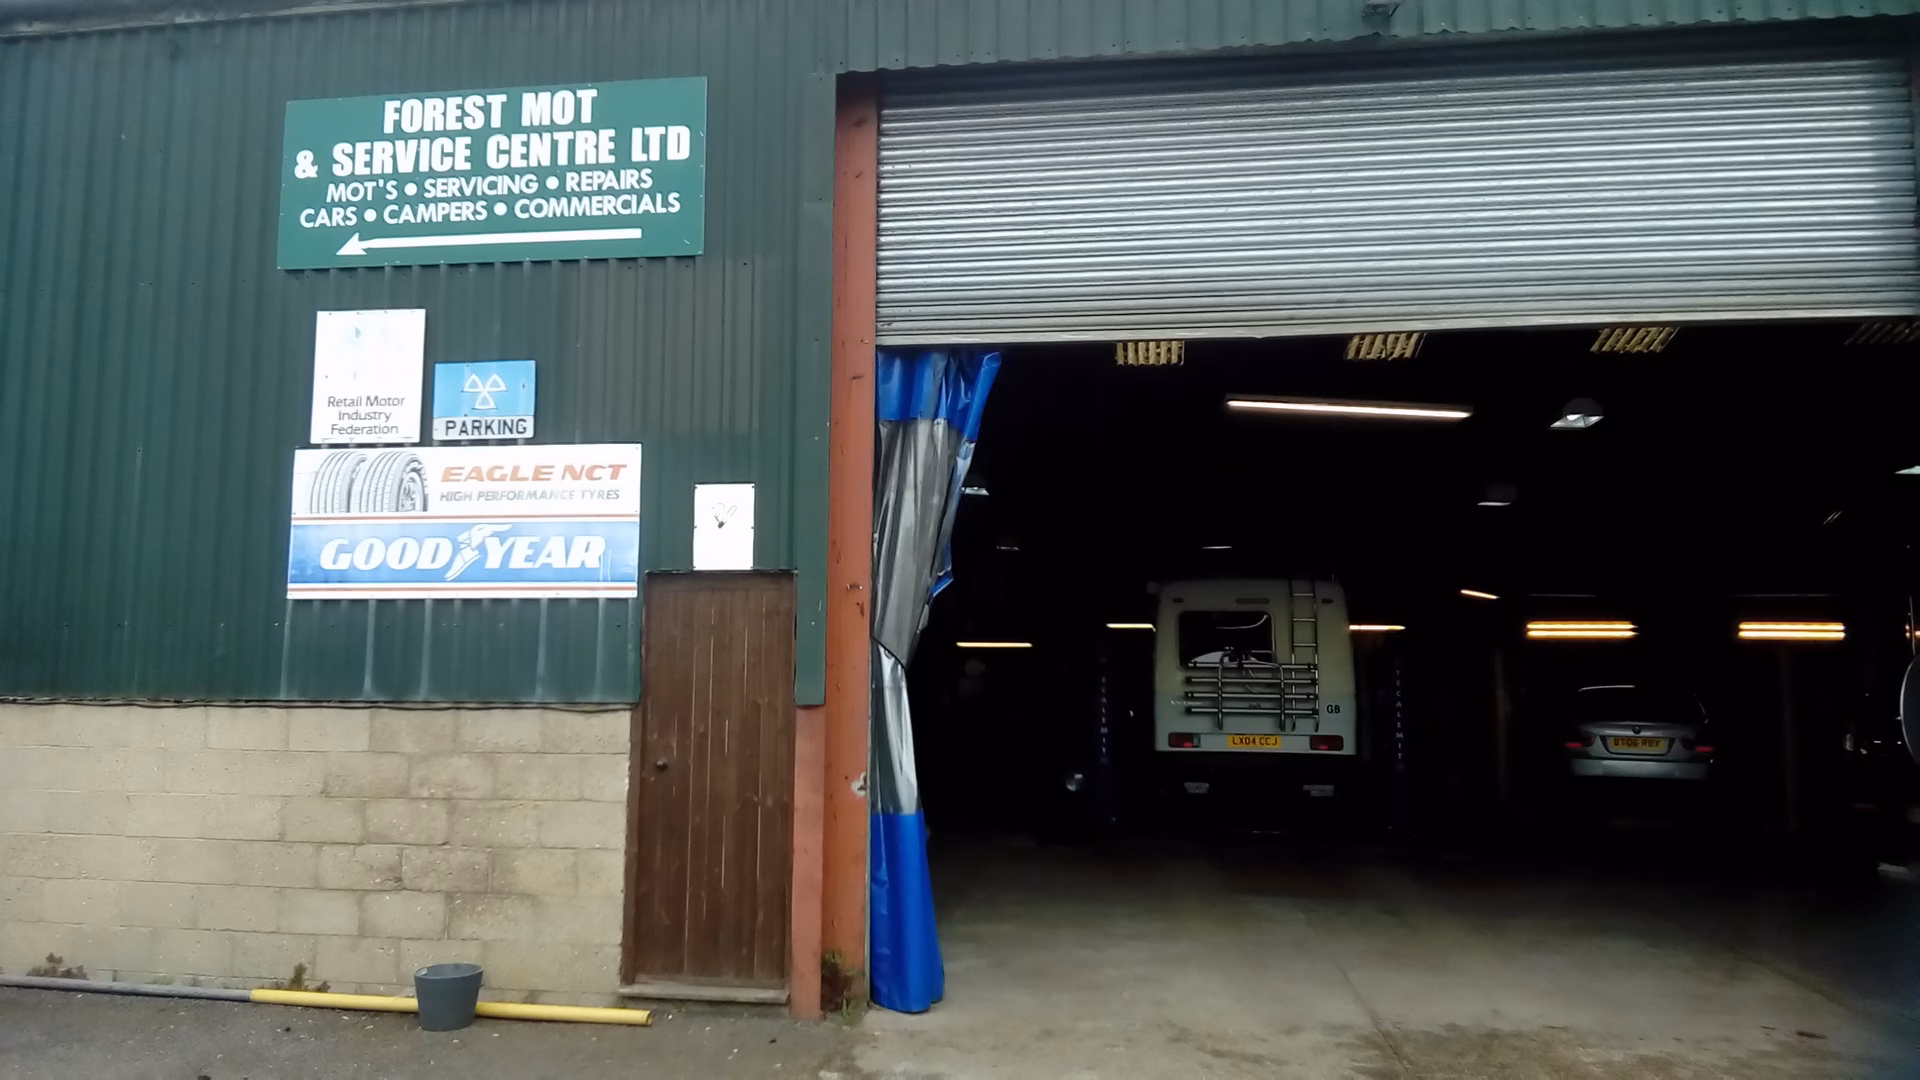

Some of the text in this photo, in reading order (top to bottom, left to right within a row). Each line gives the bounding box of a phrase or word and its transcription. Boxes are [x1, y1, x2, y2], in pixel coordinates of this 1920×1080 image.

[383, 89, 597, 134] FOREST MOT
[294, 126, 690, 179] & SERVICE CENTRE LTD
[326, 169, 653, 203] MOT'S SERVICING REPAIRS
[300, 192, 680, 228] CARS CAMPERS COMMERCIALS
[327, 395, 406, 407] Retail Motor
[338, 409, 392, 423] Industry
[331, 424, 399, 435] Federation
[445, 418, 528, 437] PARKING
[440, 464, 627, 482] EAGLE NCT
[440, 489, 620, 501] HIGH PERFORMANCE TYRES
[1326, 704, 1341, 714] GB
[1232, 736, 1278, 746] LX04 CCJ
